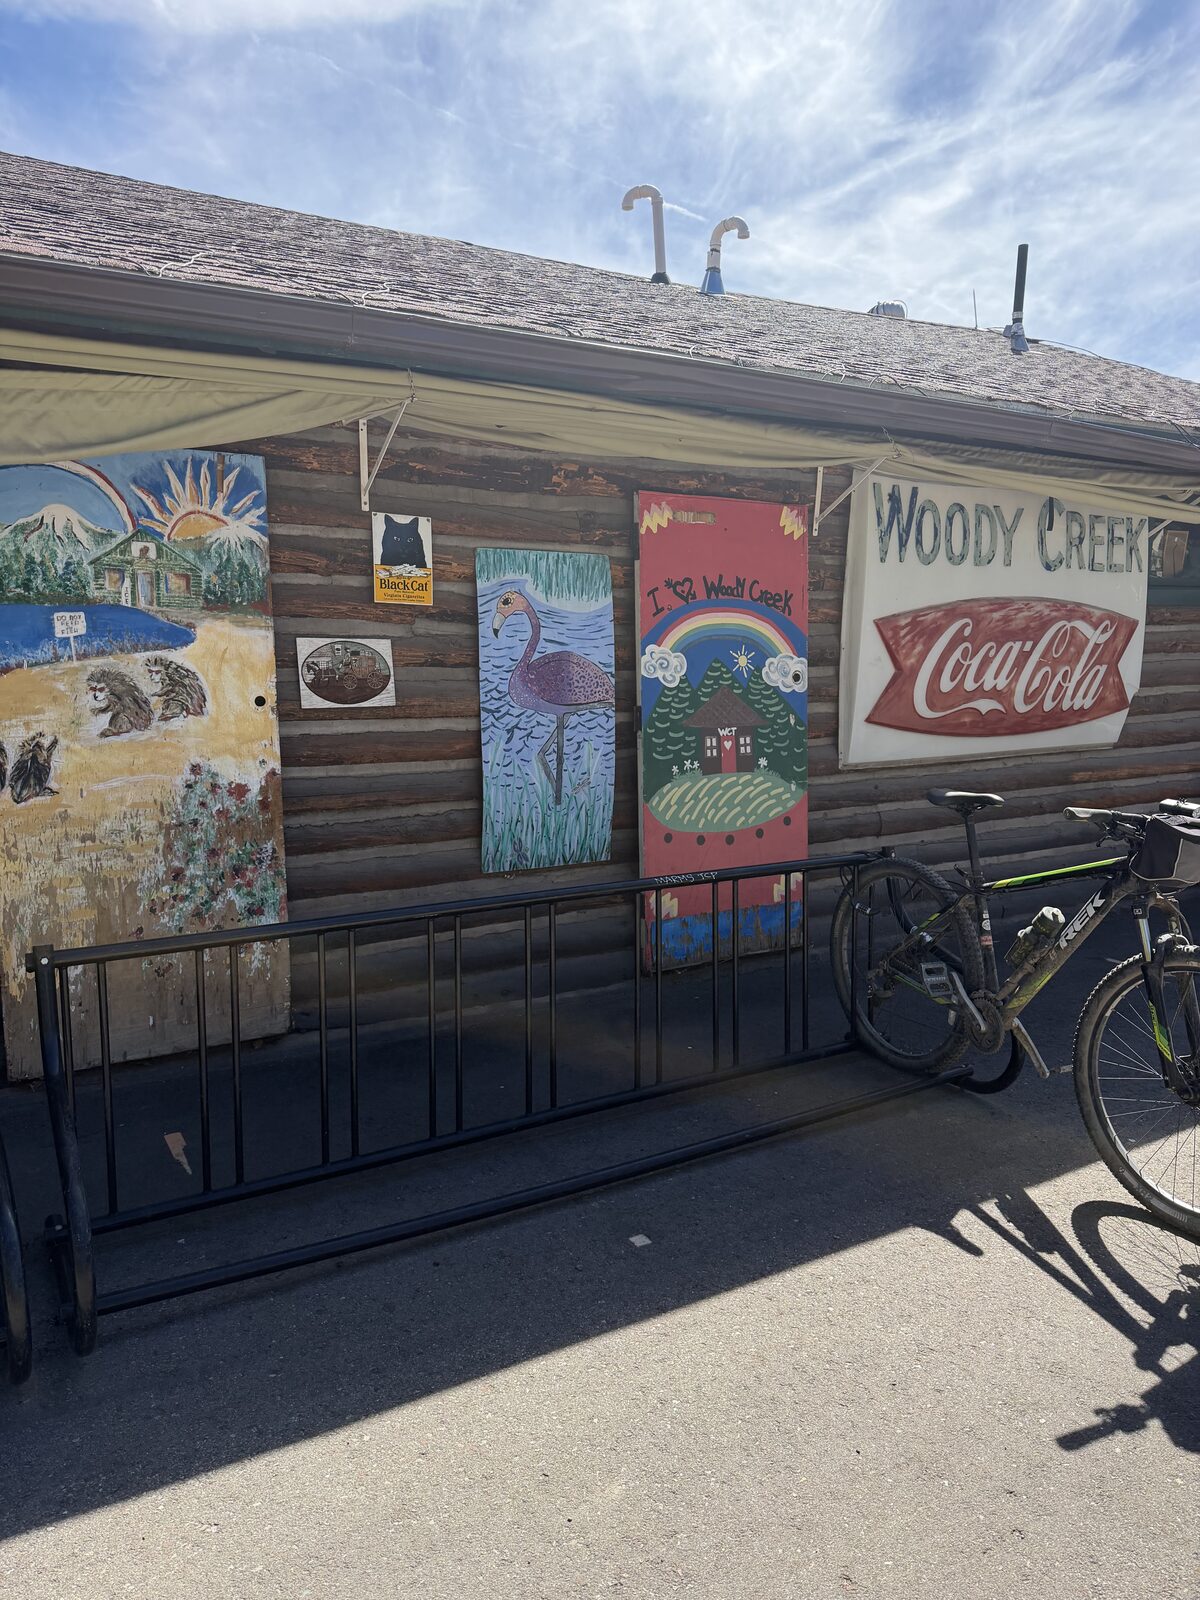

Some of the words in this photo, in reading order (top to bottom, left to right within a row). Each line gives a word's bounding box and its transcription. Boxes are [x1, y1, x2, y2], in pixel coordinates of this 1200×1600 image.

[873, 482, 1024, 567] WOODY
[1037, 496, 1147, 573] CREEK
[380, 578, 410, 591] Black
[410, 580, 428, 592] Cat
[914, 617, 1118, 719] Coca-Cola
[717, 727, 737, 737] WCT
